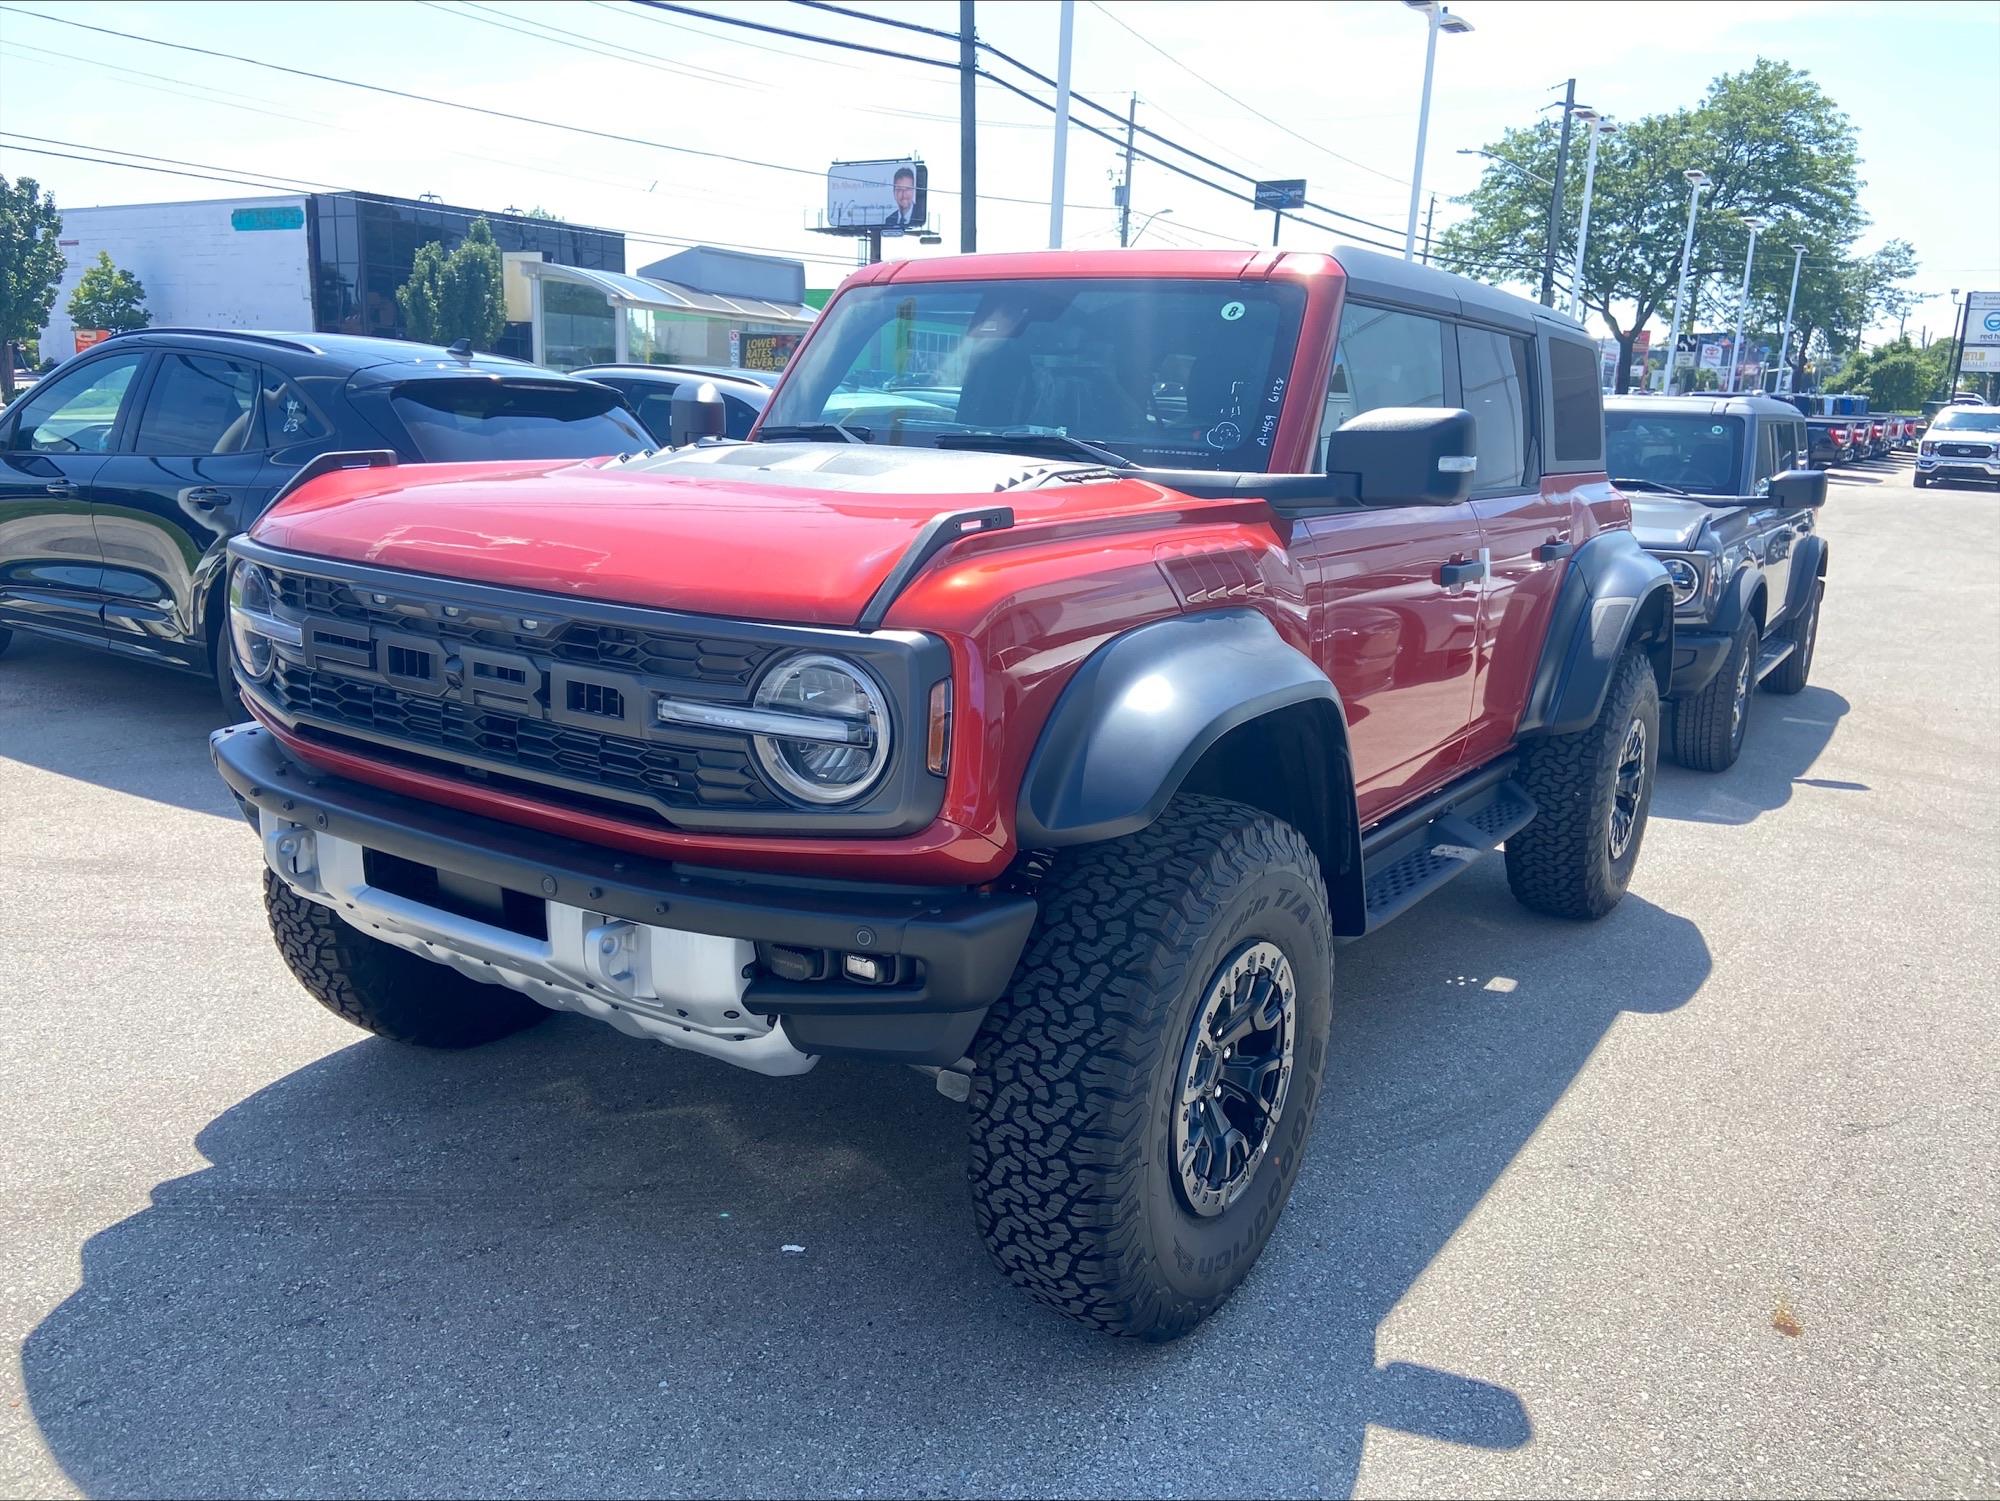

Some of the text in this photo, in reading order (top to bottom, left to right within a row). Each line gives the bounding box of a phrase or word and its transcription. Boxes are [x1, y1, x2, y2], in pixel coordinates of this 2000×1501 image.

[747, 337, 777, 349] LOWER
[746, 348, 772, 359] RATES
[745, 356, 788, 369] NEVER GO
[303, 614, 645, 738] FORD
